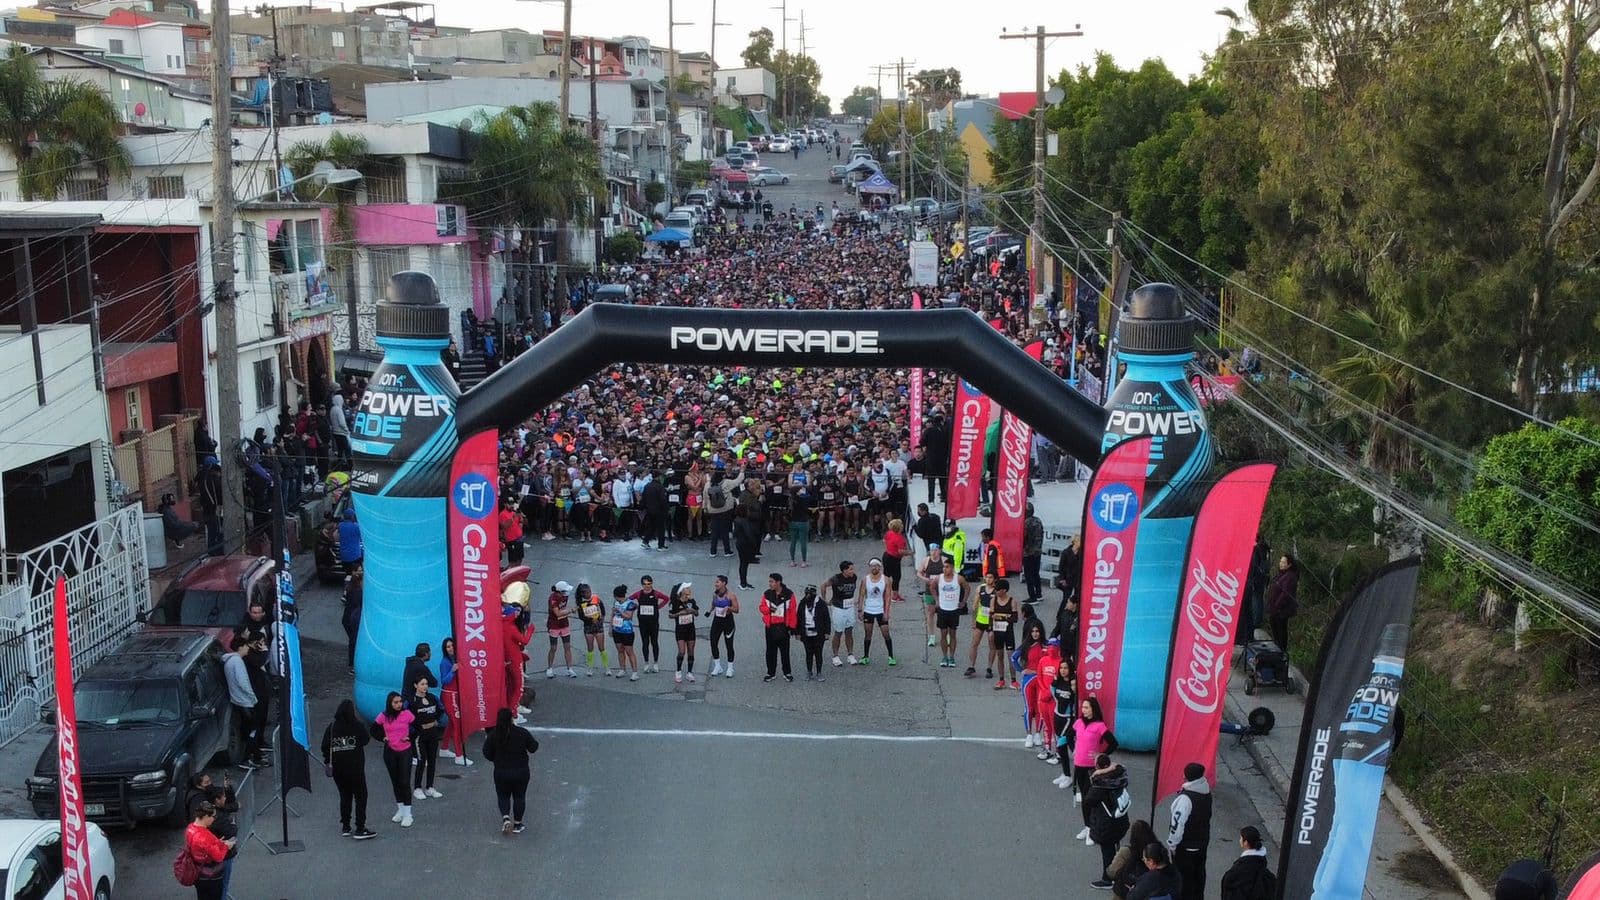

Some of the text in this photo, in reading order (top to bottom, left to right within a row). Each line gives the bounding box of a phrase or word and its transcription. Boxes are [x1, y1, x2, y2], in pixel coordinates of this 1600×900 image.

[671, 326, 879, 354] POWERADE
[353, 412, 403, 439] ADE
[358, 390, 454, 417] POWER
[1105, 409, 1205, 435] POWER
[954, 399, 981, 488] Calimax
[462, 523, 489, 643] Calimax
[1084, 536, 1124, 664] Calimax
[1175, 558, 1240, 714] Coca-Cola
[1345, 702, 1392, 723] ADE
[1298, 728, 1331, 844] POWERADE
